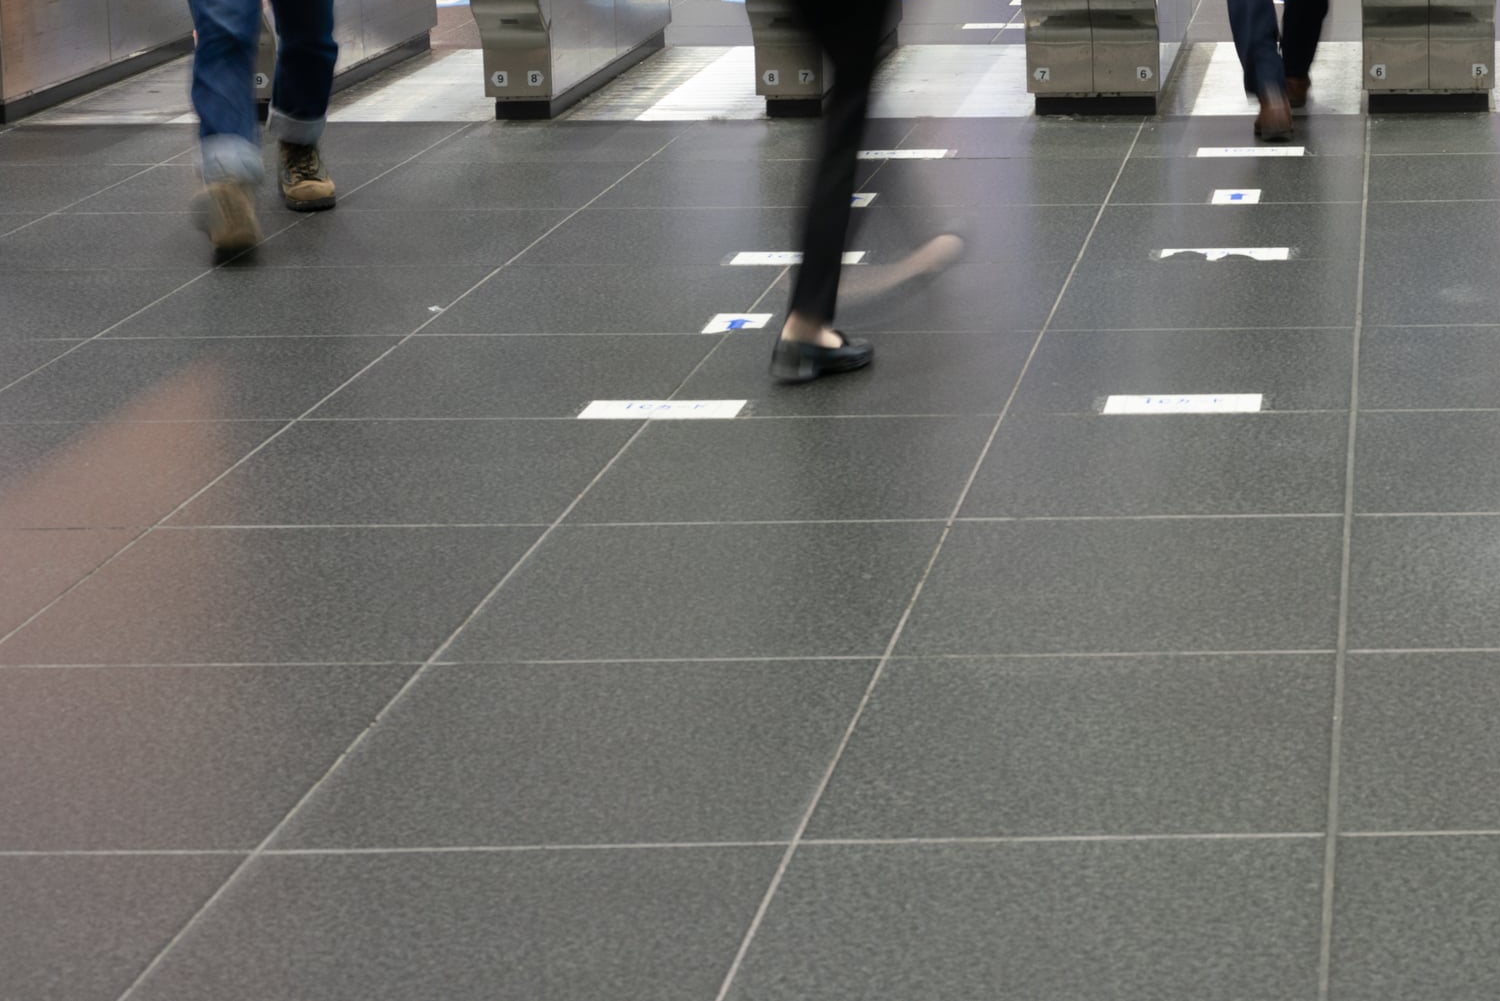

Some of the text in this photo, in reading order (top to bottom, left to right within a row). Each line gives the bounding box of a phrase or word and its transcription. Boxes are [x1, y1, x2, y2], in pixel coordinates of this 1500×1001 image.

[1039, 68, 1147, 81] 7 6
[1374, 65, 1483, 78] 6 5
[497, 73, 538, 84] 9 8
